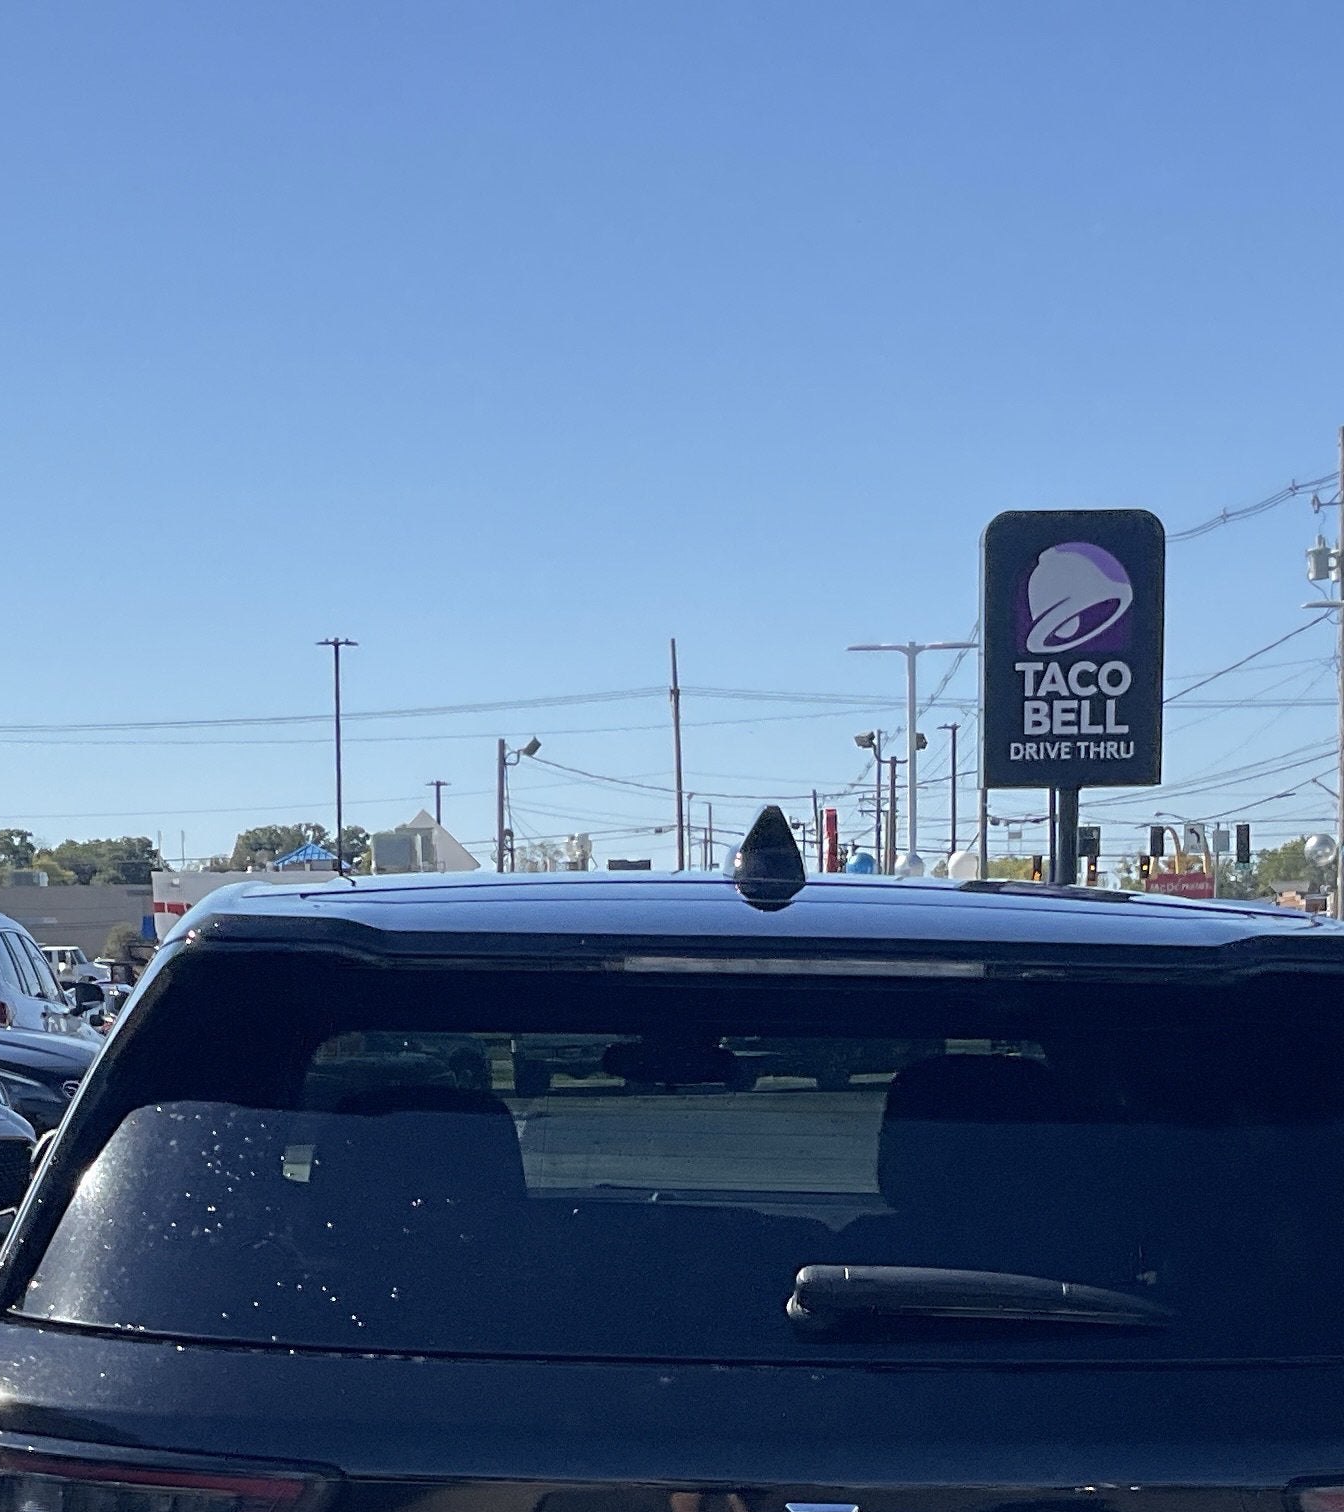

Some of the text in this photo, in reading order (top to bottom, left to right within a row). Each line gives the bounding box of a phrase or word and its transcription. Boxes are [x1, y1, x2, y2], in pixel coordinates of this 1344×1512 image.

[1015, 661, 1132, 697] TACO
[1024, 699, 1129, 735] BELL
[1010, 741, 1135, 760] DRIVE THRU
